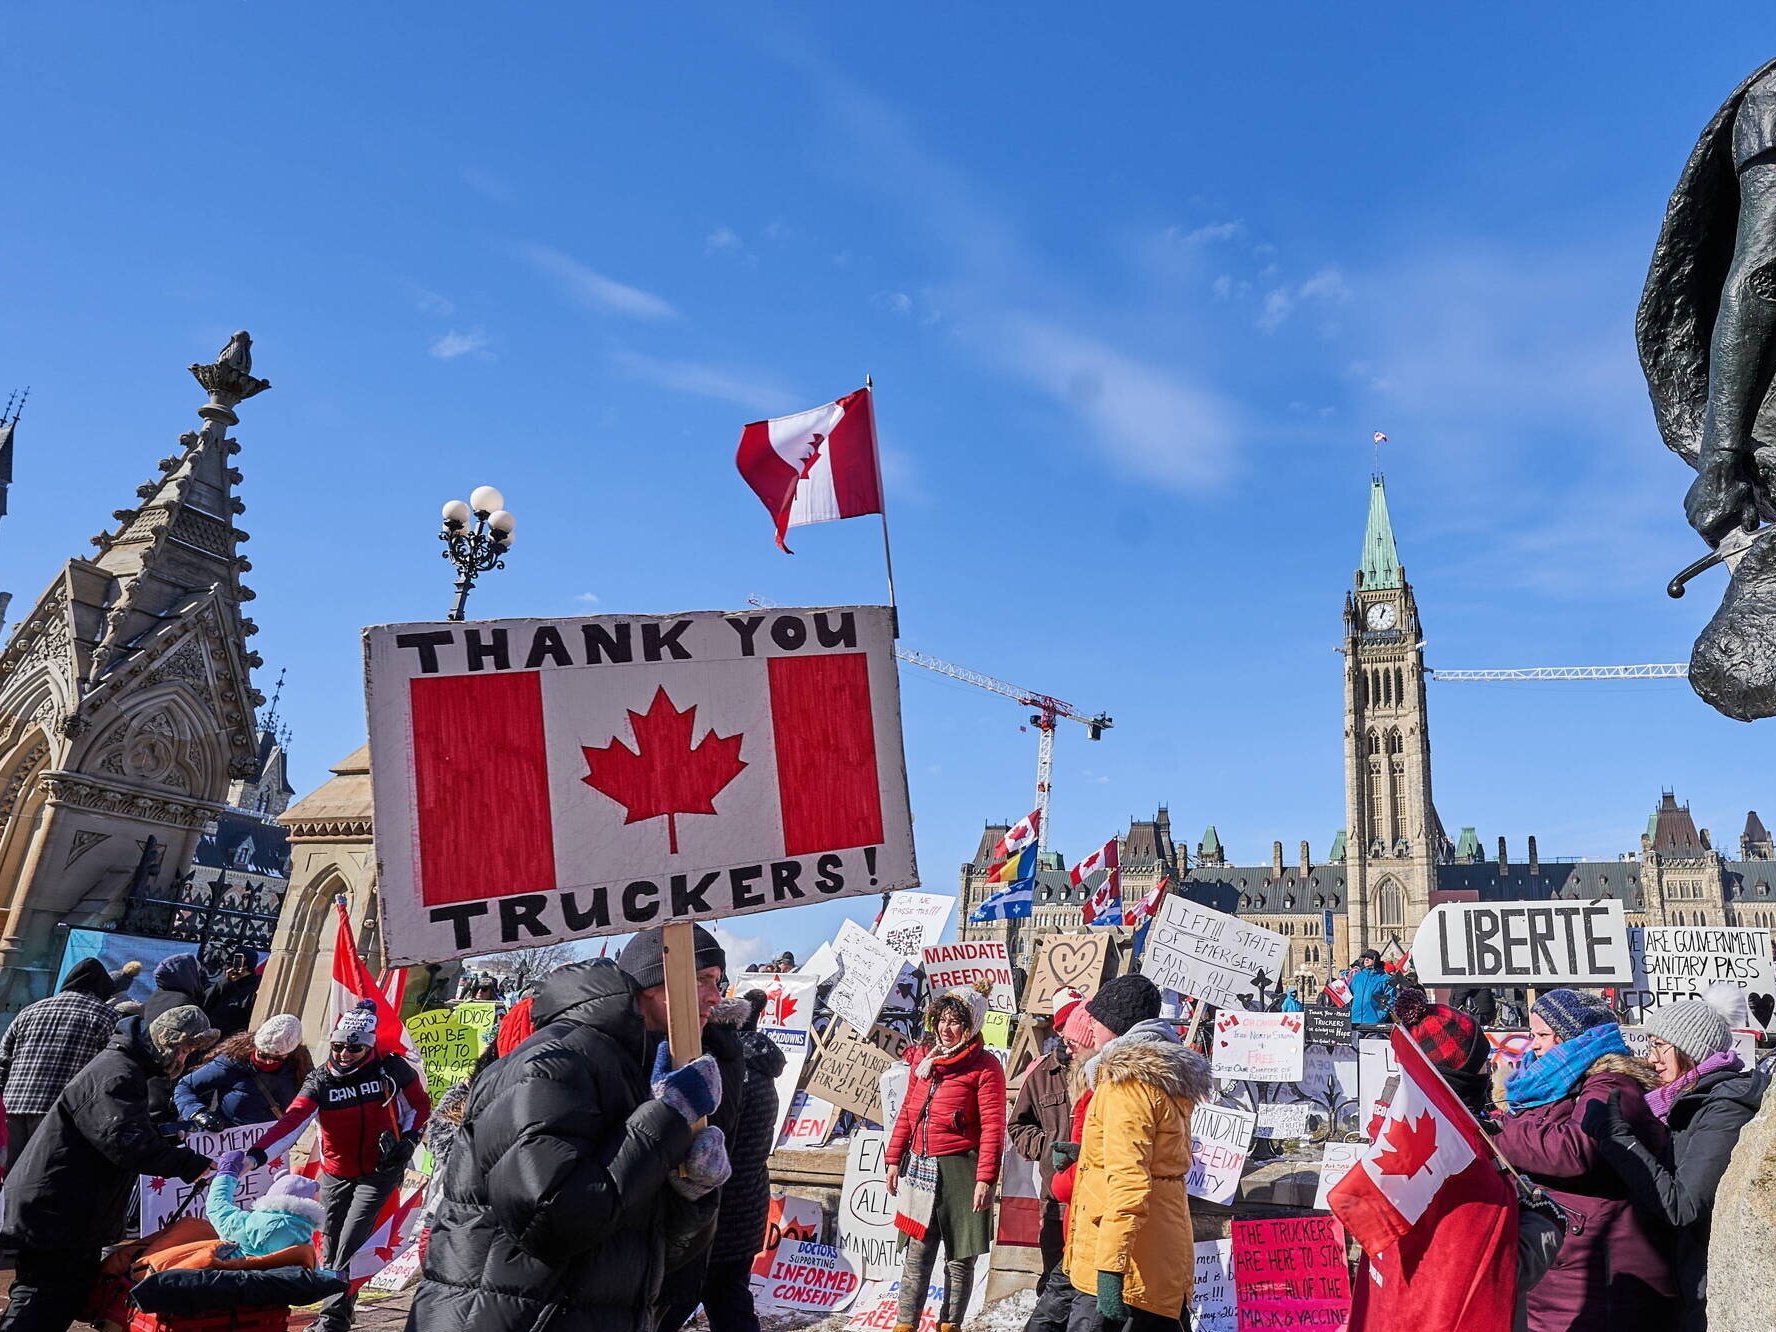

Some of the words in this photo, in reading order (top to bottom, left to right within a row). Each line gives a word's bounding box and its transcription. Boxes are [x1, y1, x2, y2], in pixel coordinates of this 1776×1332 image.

[397, 620, 693, 674] THANK
[726, 611, 858, 657] YOU
[1158, 928, 1182, 945] OF
[1166, 902, 1226, 941] LIFT!!!
[1235, 930, 1281, 957] STATE
[1438, 899, 1616, 976] LIBERTÉ
[924, 943, 1007, 965] MANDATE
[1645, 930, 1672, 953] ARE
[1674, 930, 1769, 957] GOUVERNMENT
[1152, 946, 1189, 974] END
[1207, 971, 1236, 992] ALL
[1714, 956, 1760, 979] PASS
[1657, 976, 1697, 992] LET'S
[407, 1012, 452, 1031] ONLY
[446, 1027, 469, 1042] BE
[420, 1043, 449, 1059] APPY
[455, 1043, 470, 1059] TO
[828, 1040, 846, 1052] OF
[814, 1071, 834, 1091] FOR
[1191, 1140, 1244, 1170] REEDOM
[856, 1188, 893, 1216] ALL
[1238, 1223, 1267, 1245] THE
[1270, 1219, 1335, 1244] TRUCKERS
[799, 1241, 839, 1259] DOCTORS
[1236, 1250, 1264, 1273] ARE
[1267, 1246, 1297, 1272] HERE
[1298, 1246, 1314, 1269] TO
[1321, 1244, 1345, 1269] STAY
[788, 1254, 835, 1270] SUPPORTING
[771, 1261, 860, 1294] INFORMED
[1319, 1277, 1343, 1299] THE
[772, 1284, 844, 1308] CONSENT
[1241, 1308, 1283, 1328] MASK
[1296, 1307, 1350, 1327] VACCINE
